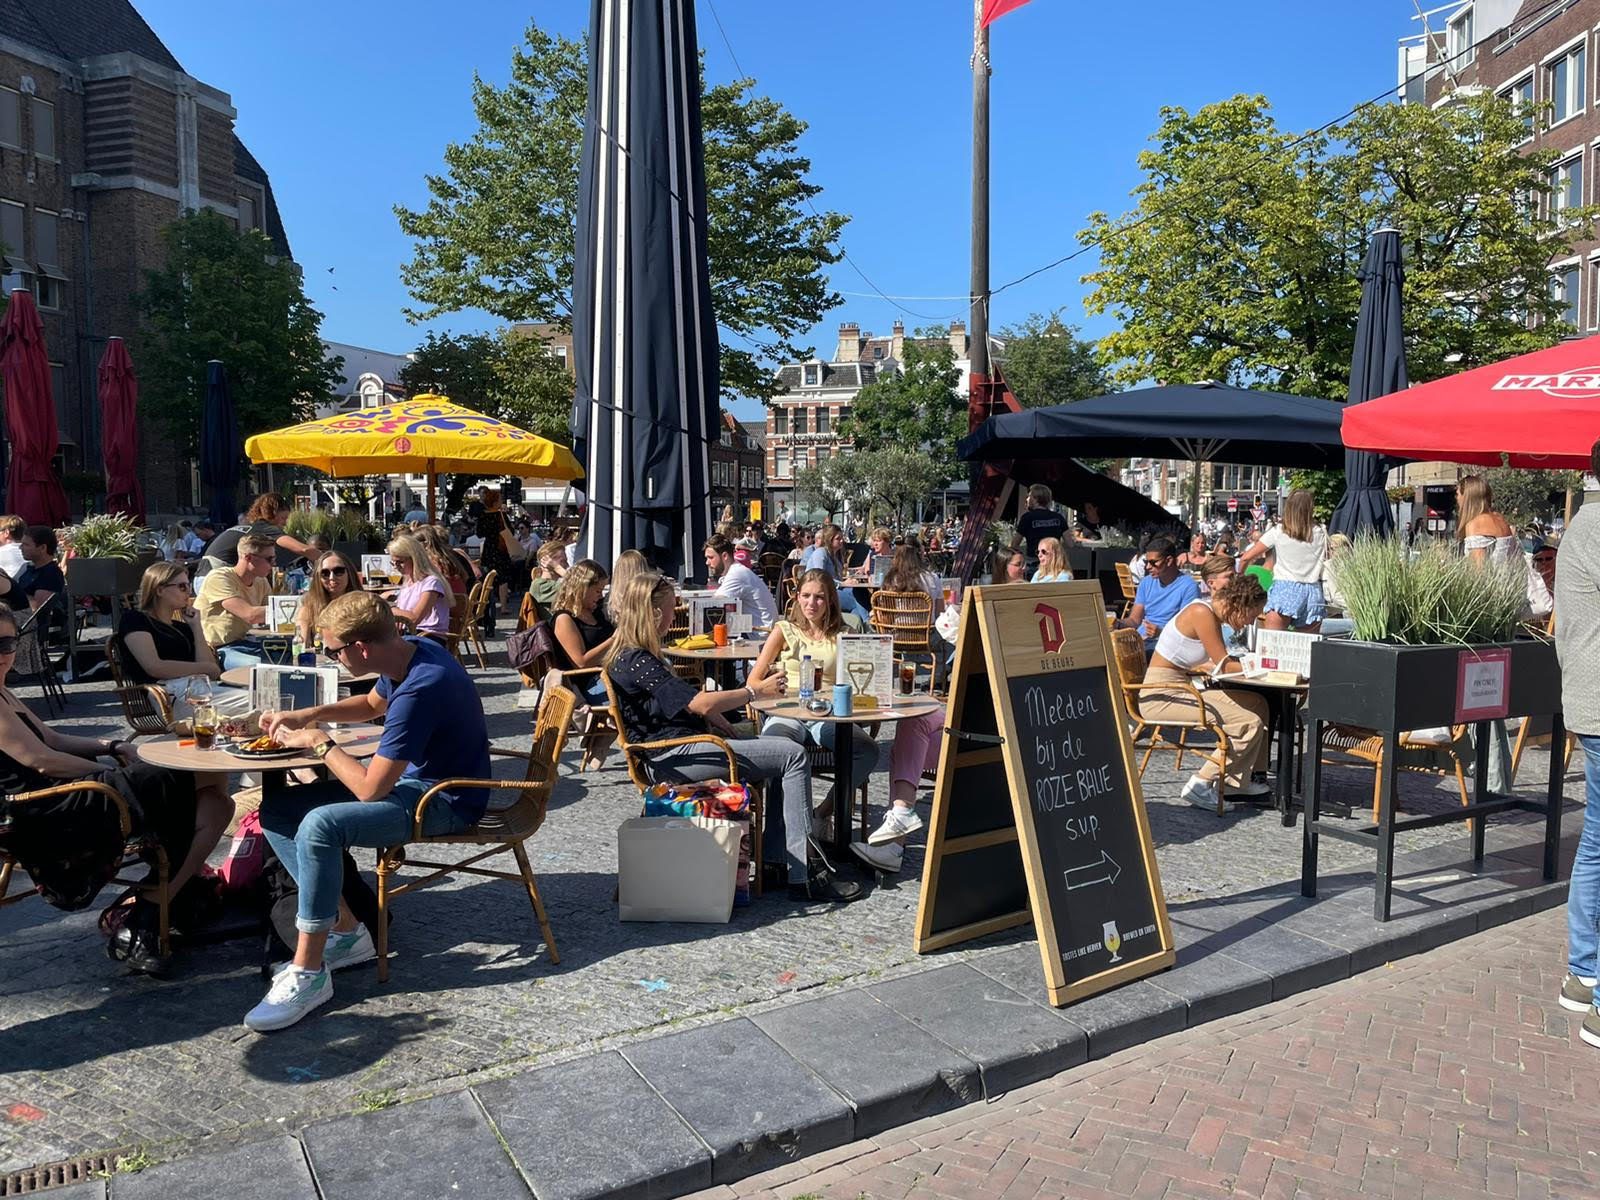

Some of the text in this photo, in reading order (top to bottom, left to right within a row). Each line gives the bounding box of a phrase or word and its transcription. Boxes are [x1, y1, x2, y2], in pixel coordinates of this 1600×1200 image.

[1502, 376, 1600, 388] MAR
[1041, 656, 1075, 670] DE BEURS
[1024, 686, 1099, 727] Melden
[1035, 731, 1086, 771] bij de
[1035, 764, 1114, 812] ROZE BALIE
[1078, 947, 1086, 957] LIKE
